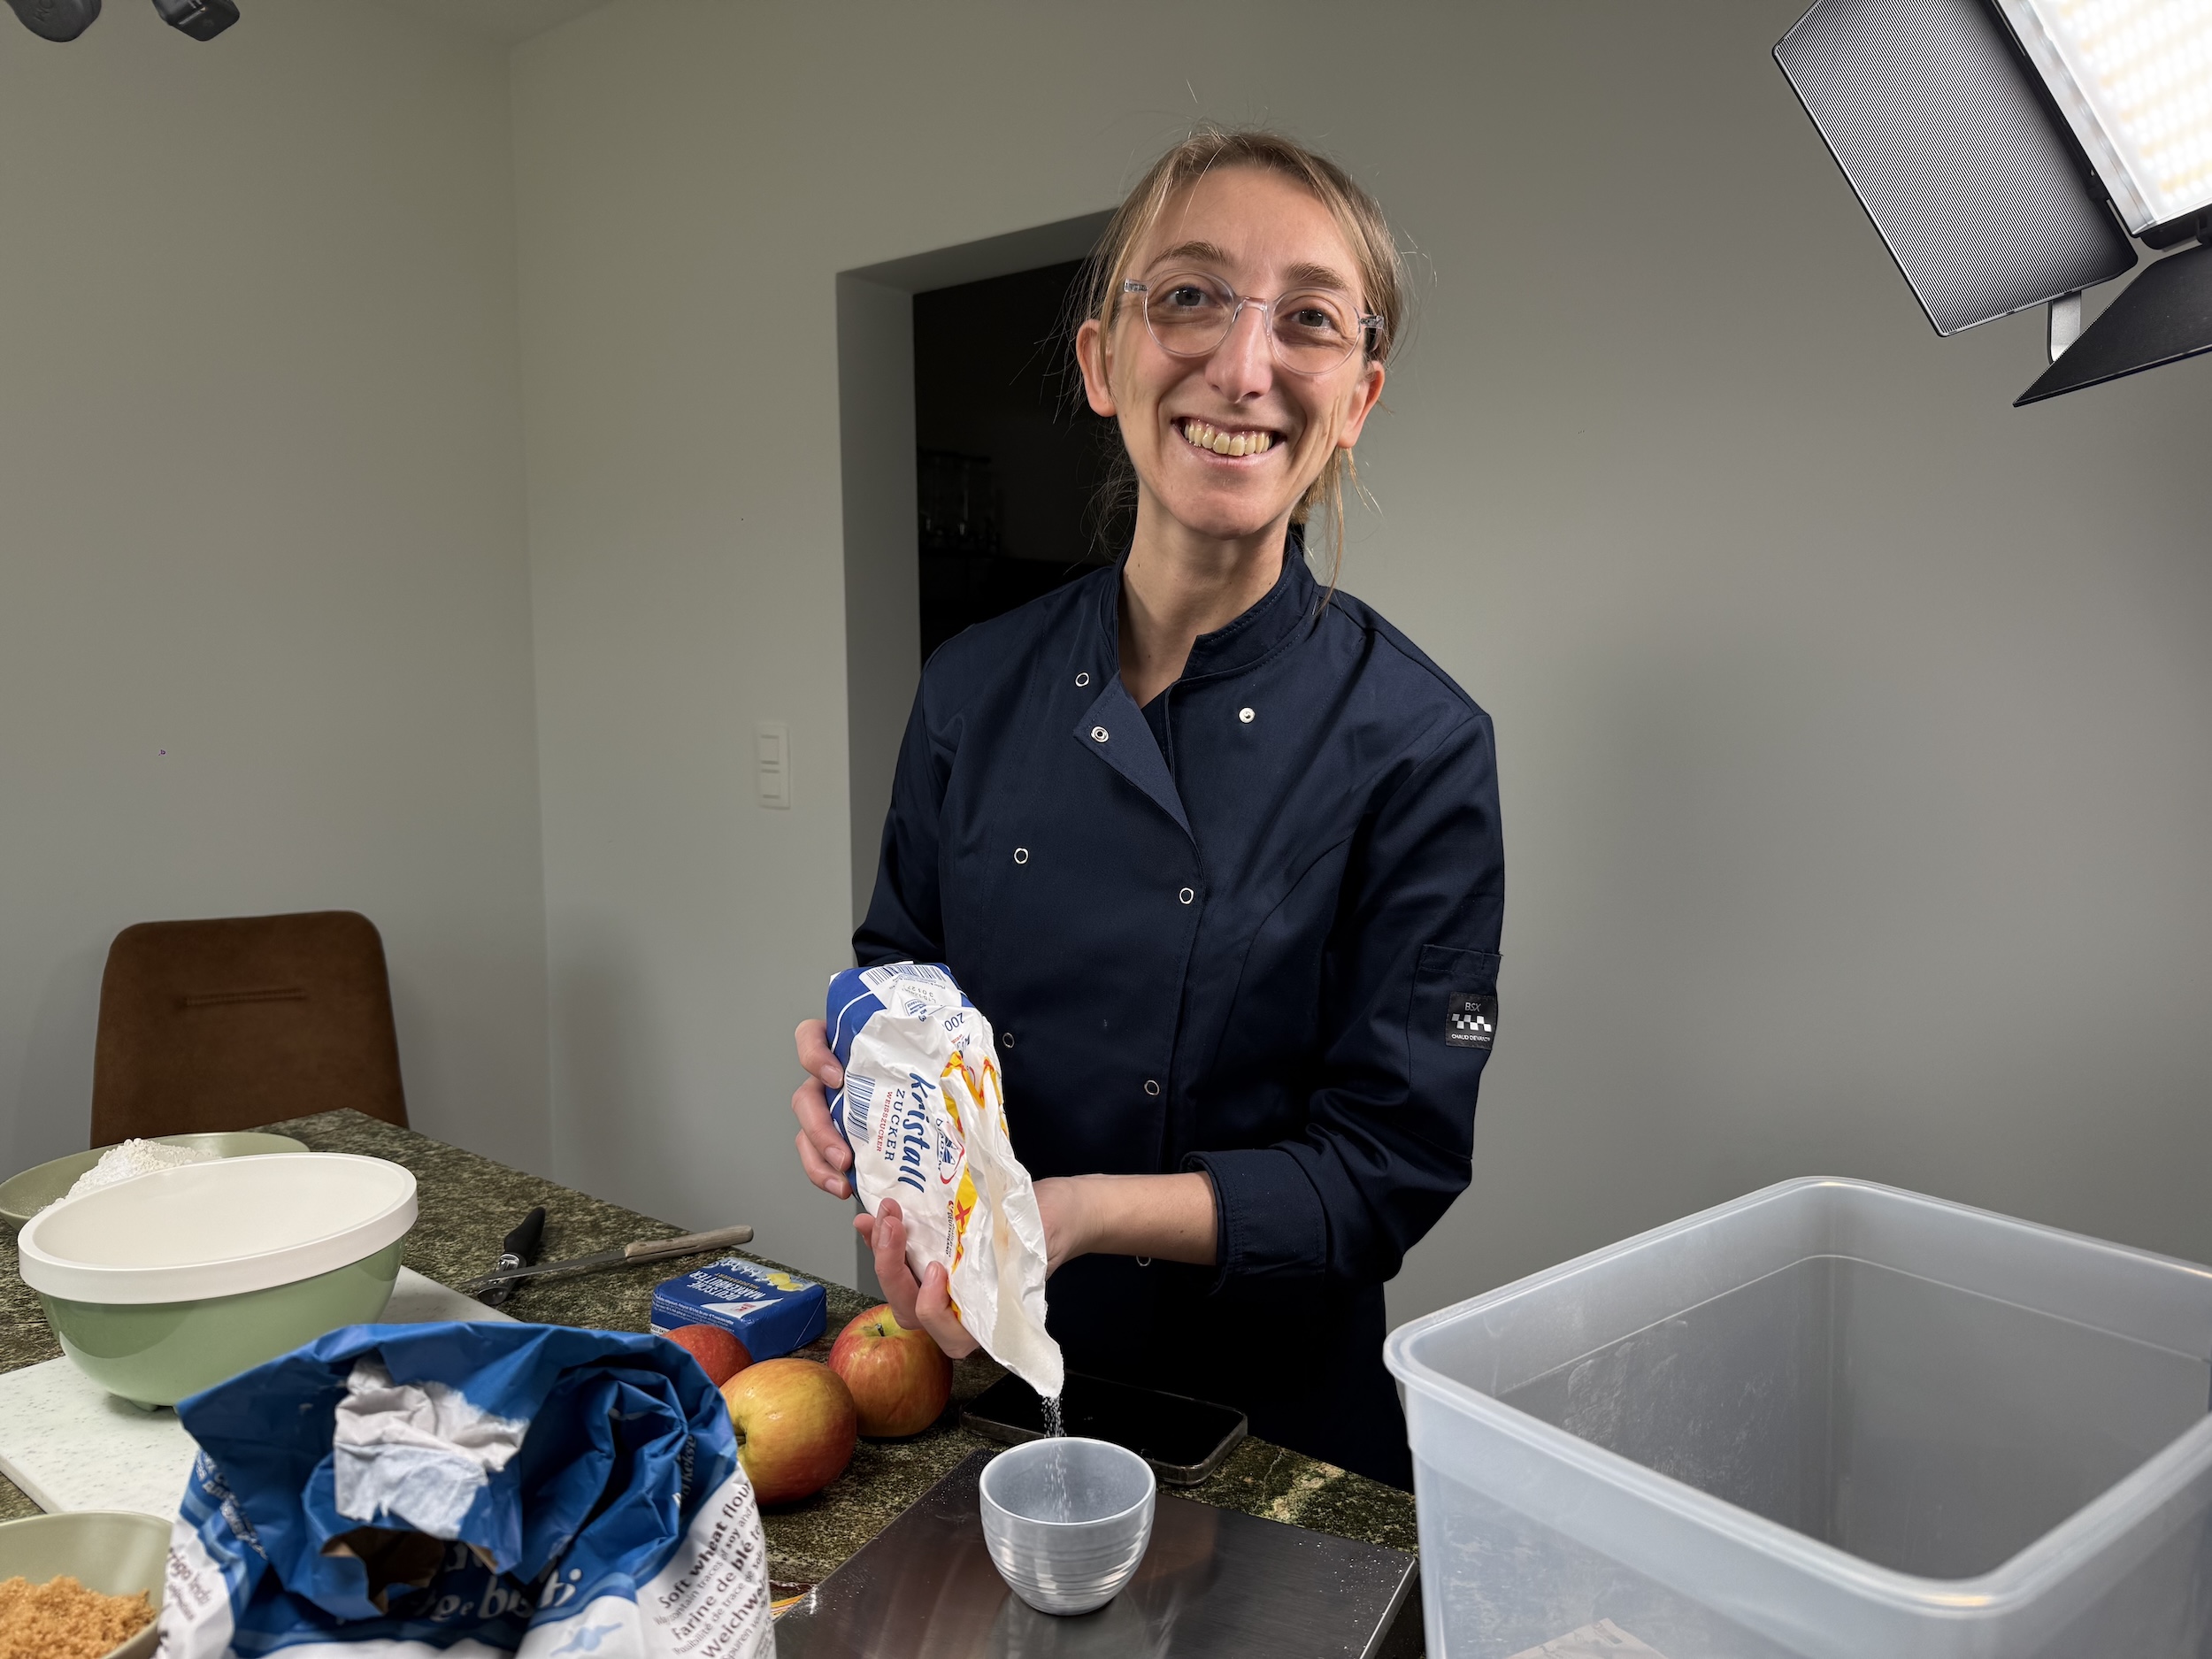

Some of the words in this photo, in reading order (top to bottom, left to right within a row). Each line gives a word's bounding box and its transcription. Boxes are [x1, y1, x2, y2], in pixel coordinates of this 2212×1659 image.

[1464, 1002, 1482, 1012] BSX
[876, 1091, 893, 1153] WEISSZUCKER
[884, 1087, 906, 1162] ZUCKER
[687, 1280, 741, 1302] DEUTSCHE
[688, 1270, 766, 1300] MARKENBUTTER
[659, 1578, 690, 1609] Soft
[688, 1521, 727, 1577] wheat
[721, 1479, 752, 1519] flour
[669, 1587, 700, 1623] contain
[697, 1560, 724, 1590] traces
[725, 1529, 741, 1551] soy
[738, 1506, 754, 1529] and
[671, 1594, 717, 1641] Farine
[717, 1570, 736, 1594] de
[730, 1538, 755, 1572] blé
[711, 1606, 726, 1623] de
[722, 1581, 746, 1608] trace
[743, 1570, 755, 1583] de
